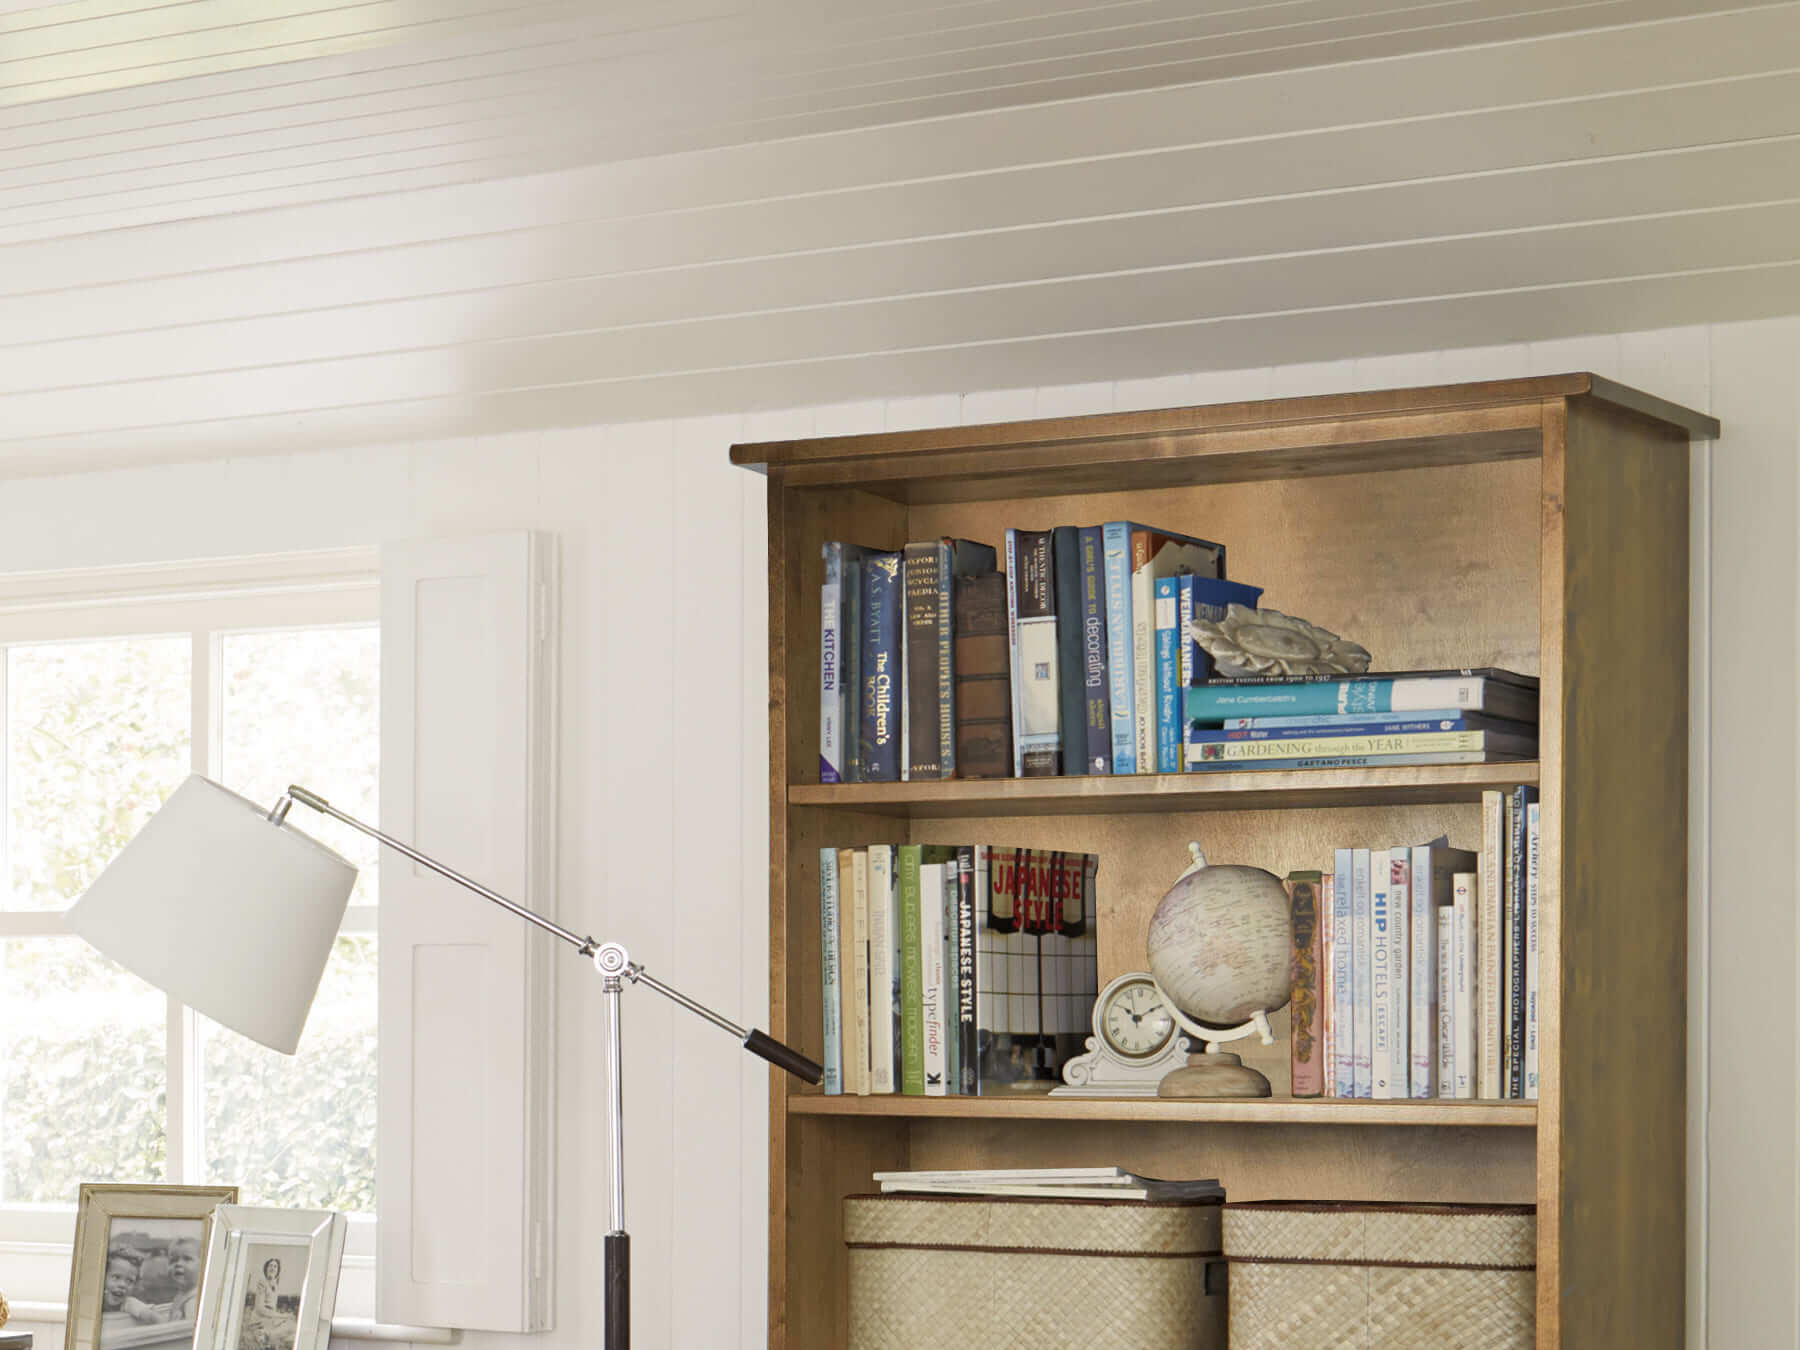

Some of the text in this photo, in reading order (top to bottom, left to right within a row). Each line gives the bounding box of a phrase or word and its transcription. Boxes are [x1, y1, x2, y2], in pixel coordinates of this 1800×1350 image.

[870, 573, 881, 645] A.S. BYATT
[1039, 582, 1048, 610] DECOR
[1088, 576, 1096, 601] GUIDE
[1089, 604, 1097, 615] TO
[939, 591, 949, 636] OTHER
[1086, 616, 1103, 687] decorating
[1181, 586, 1192, 687] WEIMARANERS
[823, 629, 835, 691] KITCHEN
[1161, 630, 1175, 724] Siblings Without Rivalry
[865, 676, 876, 718] BOOK
[876, 652, 891, 746] The Children's
[1216, 696, 1235, 705] Jane
[940, 704, 952, 757] HOUSES
[1384, 722, 1431, 732] JANE WITHERS
[1226, 742, 1312, 759] GARDENING
[1314, 742, 1349, 755] through
[1351, 742, 1365, 752] the
[1367, 738, 1403, 752] YEAR
[1297, 758, 1367, 767] GAETANO PESCE
[993, 864, 1081, 899] JAPANESE
[1394, 890, 1402, 909] new
[1012, 897, 1064, 931] STYLE
[1336, 891, 1349, 945] relaxed
[1393, 911, 1403, 946] country
[1530, 908, 1537, 917] TO
[959, 901, 972, 1023] JAPANESE STYLE
[1375, 893, 1388, 999] HIP HOTELS
[1393, 948, 1403, 980] garden
[1486, 845, 1497, 1073] SCANDINAVIAN PAINTED FURNITURE
[1337, 950, 1349, 994] home
[1512, 926, 1520, 1021] PHOTOGRAPHERS
[922, 986, 940, 1057] typefinder
[1377, 1008, 1386, 1049] ESCAPE
[1441, 1014, 1451, 1041] Oscar
[1512, 1026, 1520, 1071] SPECIAL
[1512, 1076, 1520, 1096] THE
